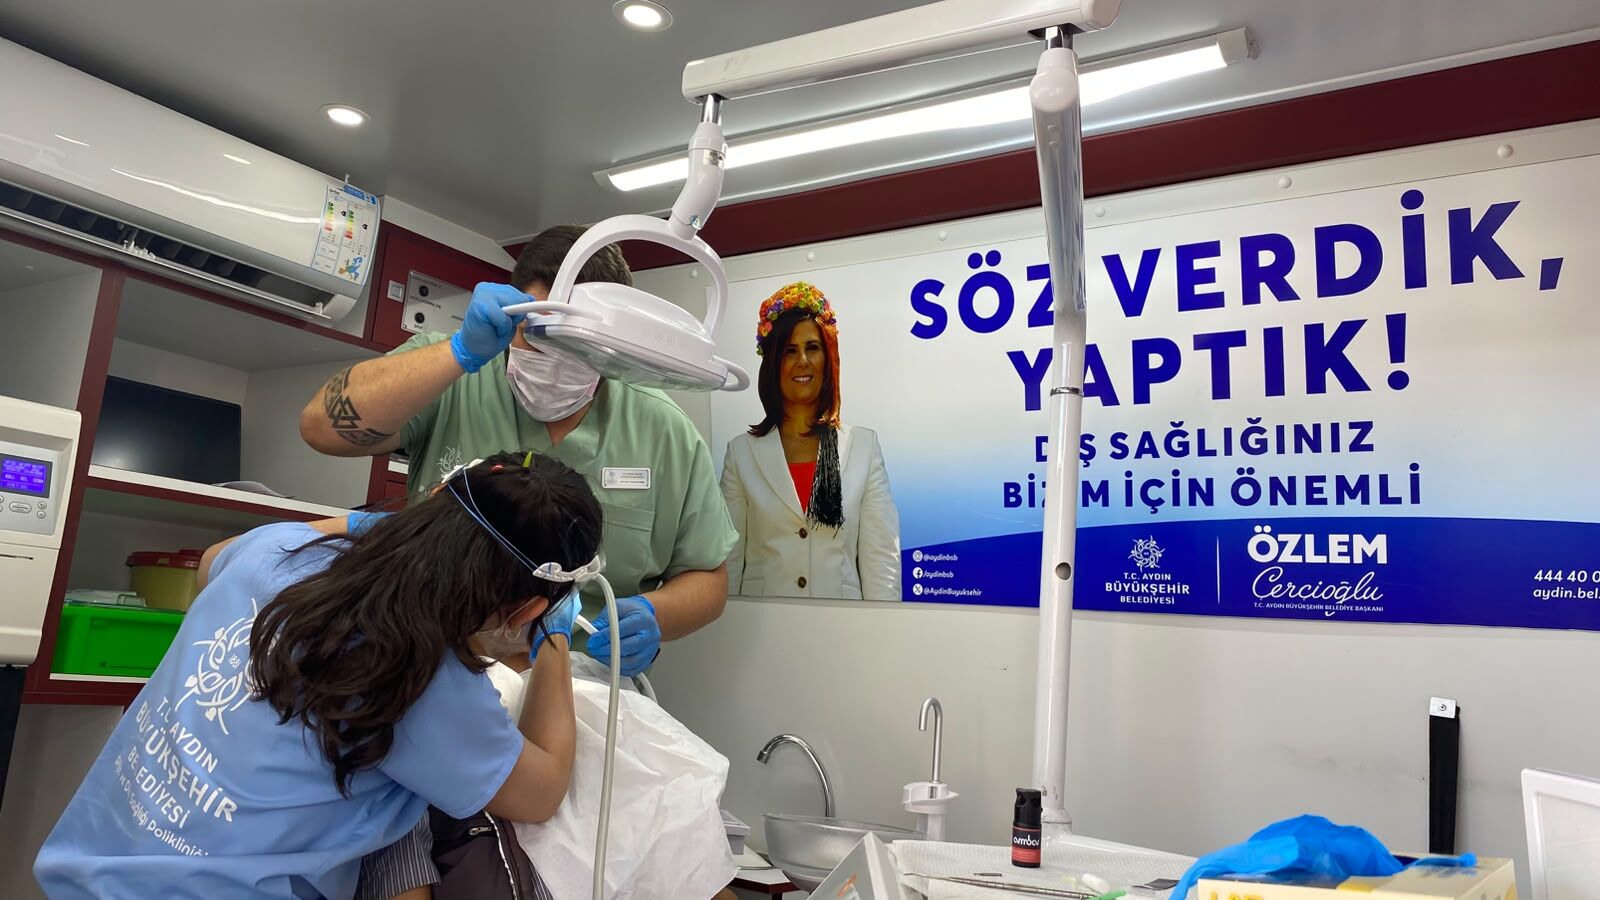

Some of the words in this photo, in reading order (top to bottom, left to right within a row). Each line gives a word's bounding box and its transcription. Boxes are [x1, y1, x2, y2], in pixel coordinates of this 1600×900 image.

[910, 249, 1055, 340] SÖZ
[1102, 189, 1564, 318] VERDİK,
[1006, 312, 1408, 412] YAPTIK!
[1035, 433, 1097, 468] DŞ
[1109, 417, 1375, 460] SAĞLIĞINIZ
[1003, 472, 1110, 508] BİM
[1124, 468, 1215, 514] İÇİN
[1230, 462, 1422, 507] ÖNEMLİ
[923, 553, 959, 562] @aydinbsb
[1247, 525, 1388, 564] ÖZLEM
[1105, 580, 1190, 596] BÜYÜKŞEHİR
[1123, 572, 1140, 580] T.C.
[1142, 573, 1171, 581] AYDIN
[1533, 569, 1563, 582] 444
[1566, 570, 1588, 583] 40
[1120, 595, 1175, 605] BELEDİYESİ
[1285, 603, 1324, 611] BÜYÜKŞEHİR
[1324, 604, 1354, 612] BELEDİYE
[1354, 605, 1385, 613] BAŞKANI
[170, 721, 218, 774] AYDIN
[127, 745, 191, 830] BEEDİYESİ
